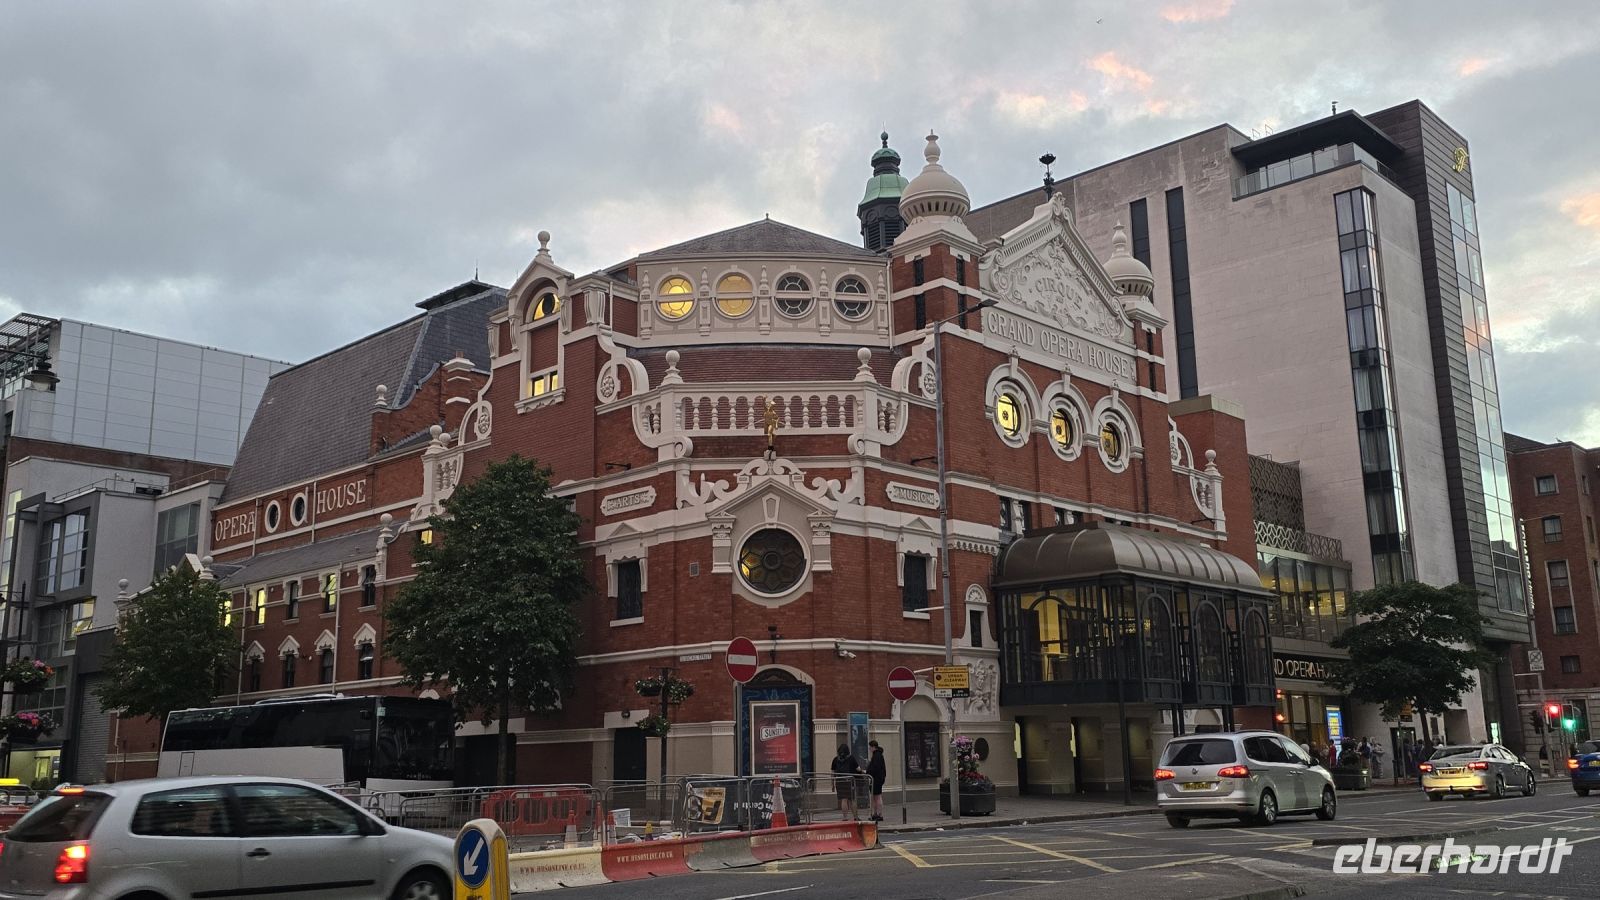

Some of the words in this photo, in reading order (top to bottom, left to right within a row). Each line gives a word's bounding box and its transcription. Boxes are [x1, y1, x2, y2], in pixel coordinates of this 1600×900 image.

[1035, 277, 1083, 311] CIRQUE
[987, 311, 1035, 346] GRAND
[1040, 329, 1085, 364] OPERA
[1087, 344, 1129, 378] HOUSE
[615, 493, 641, 508] ARTS
[898, 487, 927, 503] MUSIC
[214, 510, 255, 542] OPERA
[316, 478, 366, 514] HOUSE
[1285, 659, 1317, 678] OPERA
